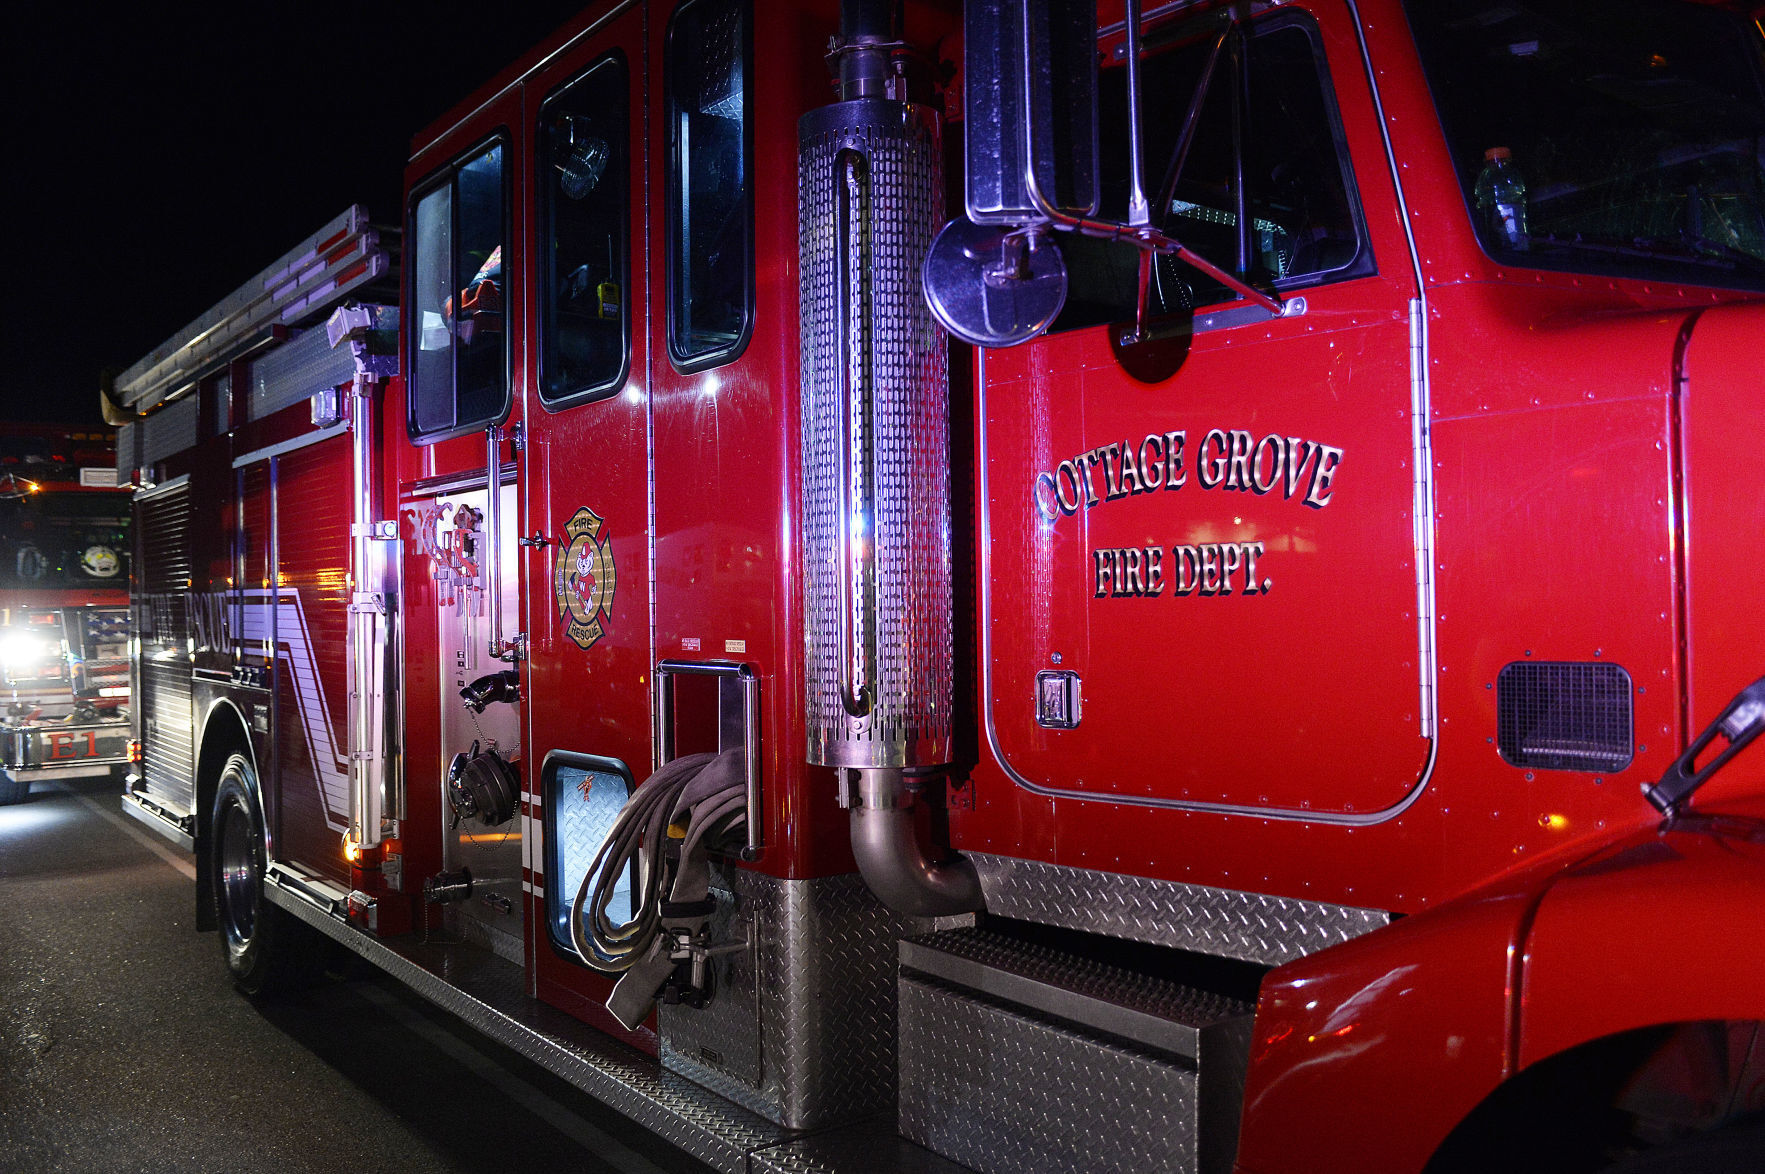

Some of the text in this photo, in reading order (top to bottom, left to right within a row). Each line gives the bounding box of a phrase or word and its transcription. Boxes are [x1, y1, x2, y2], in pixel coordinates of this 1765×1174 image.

[1034, 429, 1344, 519] COTTAGE GROVE
[574, 517, 593, 532] FIRE
[1093, 542, 1272, 598] FIRE DEPT.
[572, 624, 599, 640] RESCUE
[48, 731, 101, 760] E1
